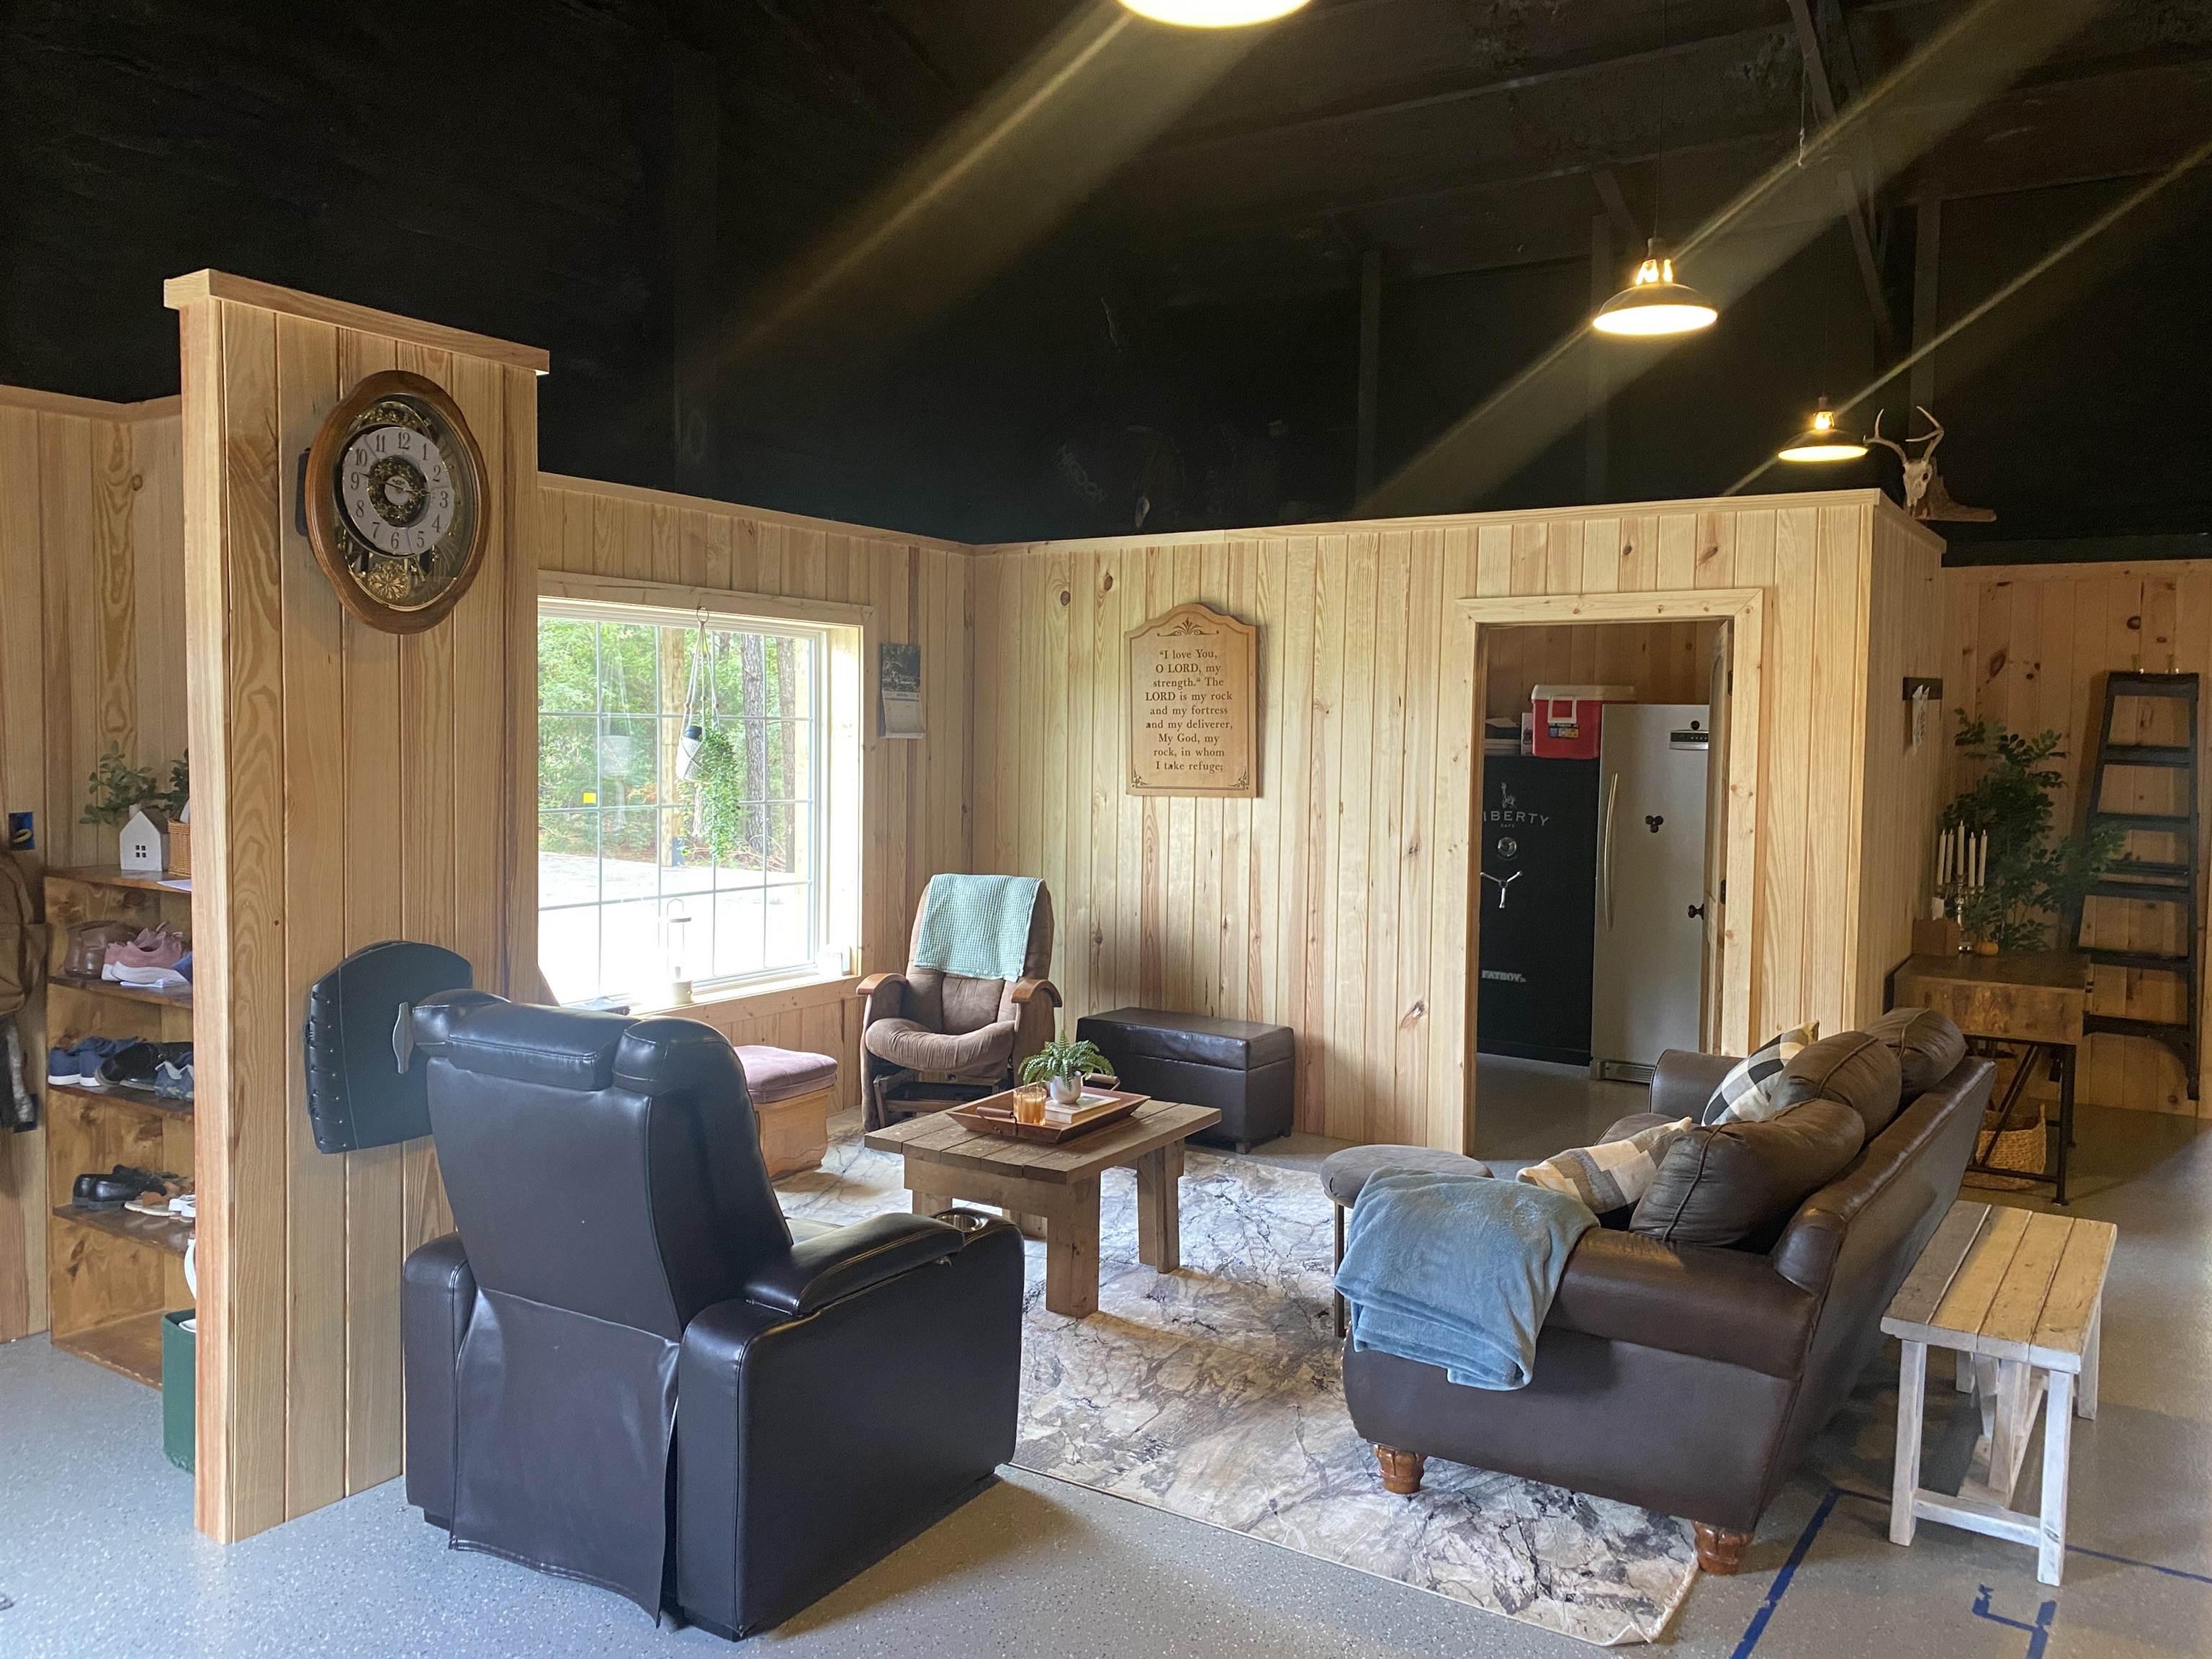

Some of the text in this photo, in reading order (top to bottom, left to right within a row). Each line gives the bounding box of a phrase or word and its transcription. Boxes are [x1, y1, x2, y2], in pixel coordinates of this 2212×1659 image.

[376, 434, 386, 452] 11
[397, 432, 410, 450] 12
[355, 449, 368, 467] 10
[423, 443, 428, 461] 1
[351, 472, 359, 490] 9
[433, 464, 441, 482] 2
[439, 491, 448, 508] 3
[356, 500, 364, 518] 8
[372, 521, 380, 539] 7
[432, 514, 441, 533] 4
[391, 531, 399, 549] 6
[416, 530, 424, 547] 5
[1173, 650, 1192, 659] love
[1195, 649, 1217, 660] You,
[1156, 663, 1221, 675] O LORD, my
[1205, 677, 1224, 686] The
[1146, 691, 1233, 703] LORD is my rock
[1150, 705, 1228, 718] and my fortress
[1146, 719, 1233, 732] and my deliverer,
[1159, 733, 1220, 746] My God, my
[1154, 747, 1225, 757] rock, in whom
[1156, 760, 1223, 773] I take refuge;
[1483, 810, 1549, 827] IBERTY
